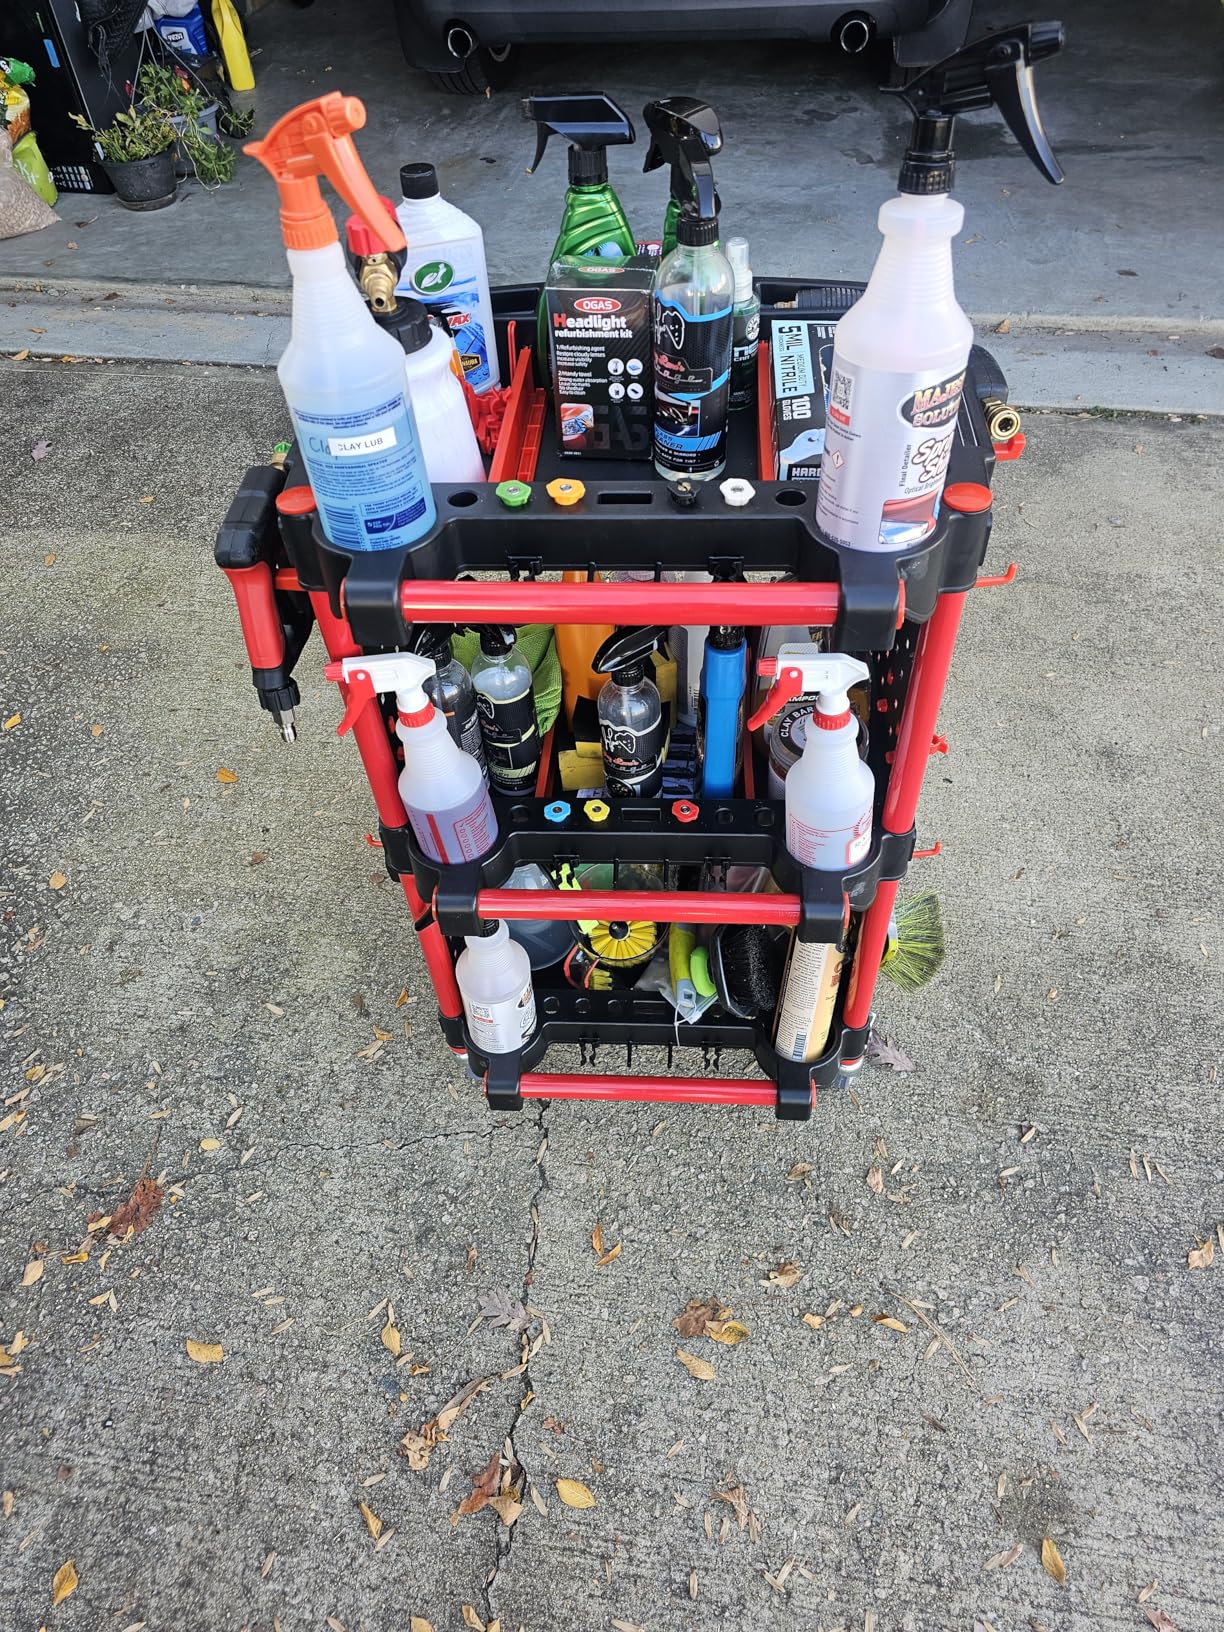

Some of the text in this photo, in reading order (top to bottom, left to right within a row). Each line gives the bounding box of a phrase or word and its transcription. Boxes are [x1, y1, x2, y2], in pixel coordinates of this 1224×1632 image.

[583, 301, 613, 310] OGAS
[553, 313, 627, 330] Headlight
[778, 325, 802, 334] 5
[555, 329, 633, 338] refurbishment kit
[785, 333, 803, 351] MIL
[780, 355, 798, 393] NITRILE
[797, 353, 807, 387] MEDIUM DUTY
[782, 399, 792, 421] GLOVES
[791, 396, 812, 420] 100
[364, 437, 384, 448] LUB
[898, 444, 912, 487] Final Detailer
[904, 484, 924, 494] Optical
[781, 706, 814, 738] CLAY BAR
